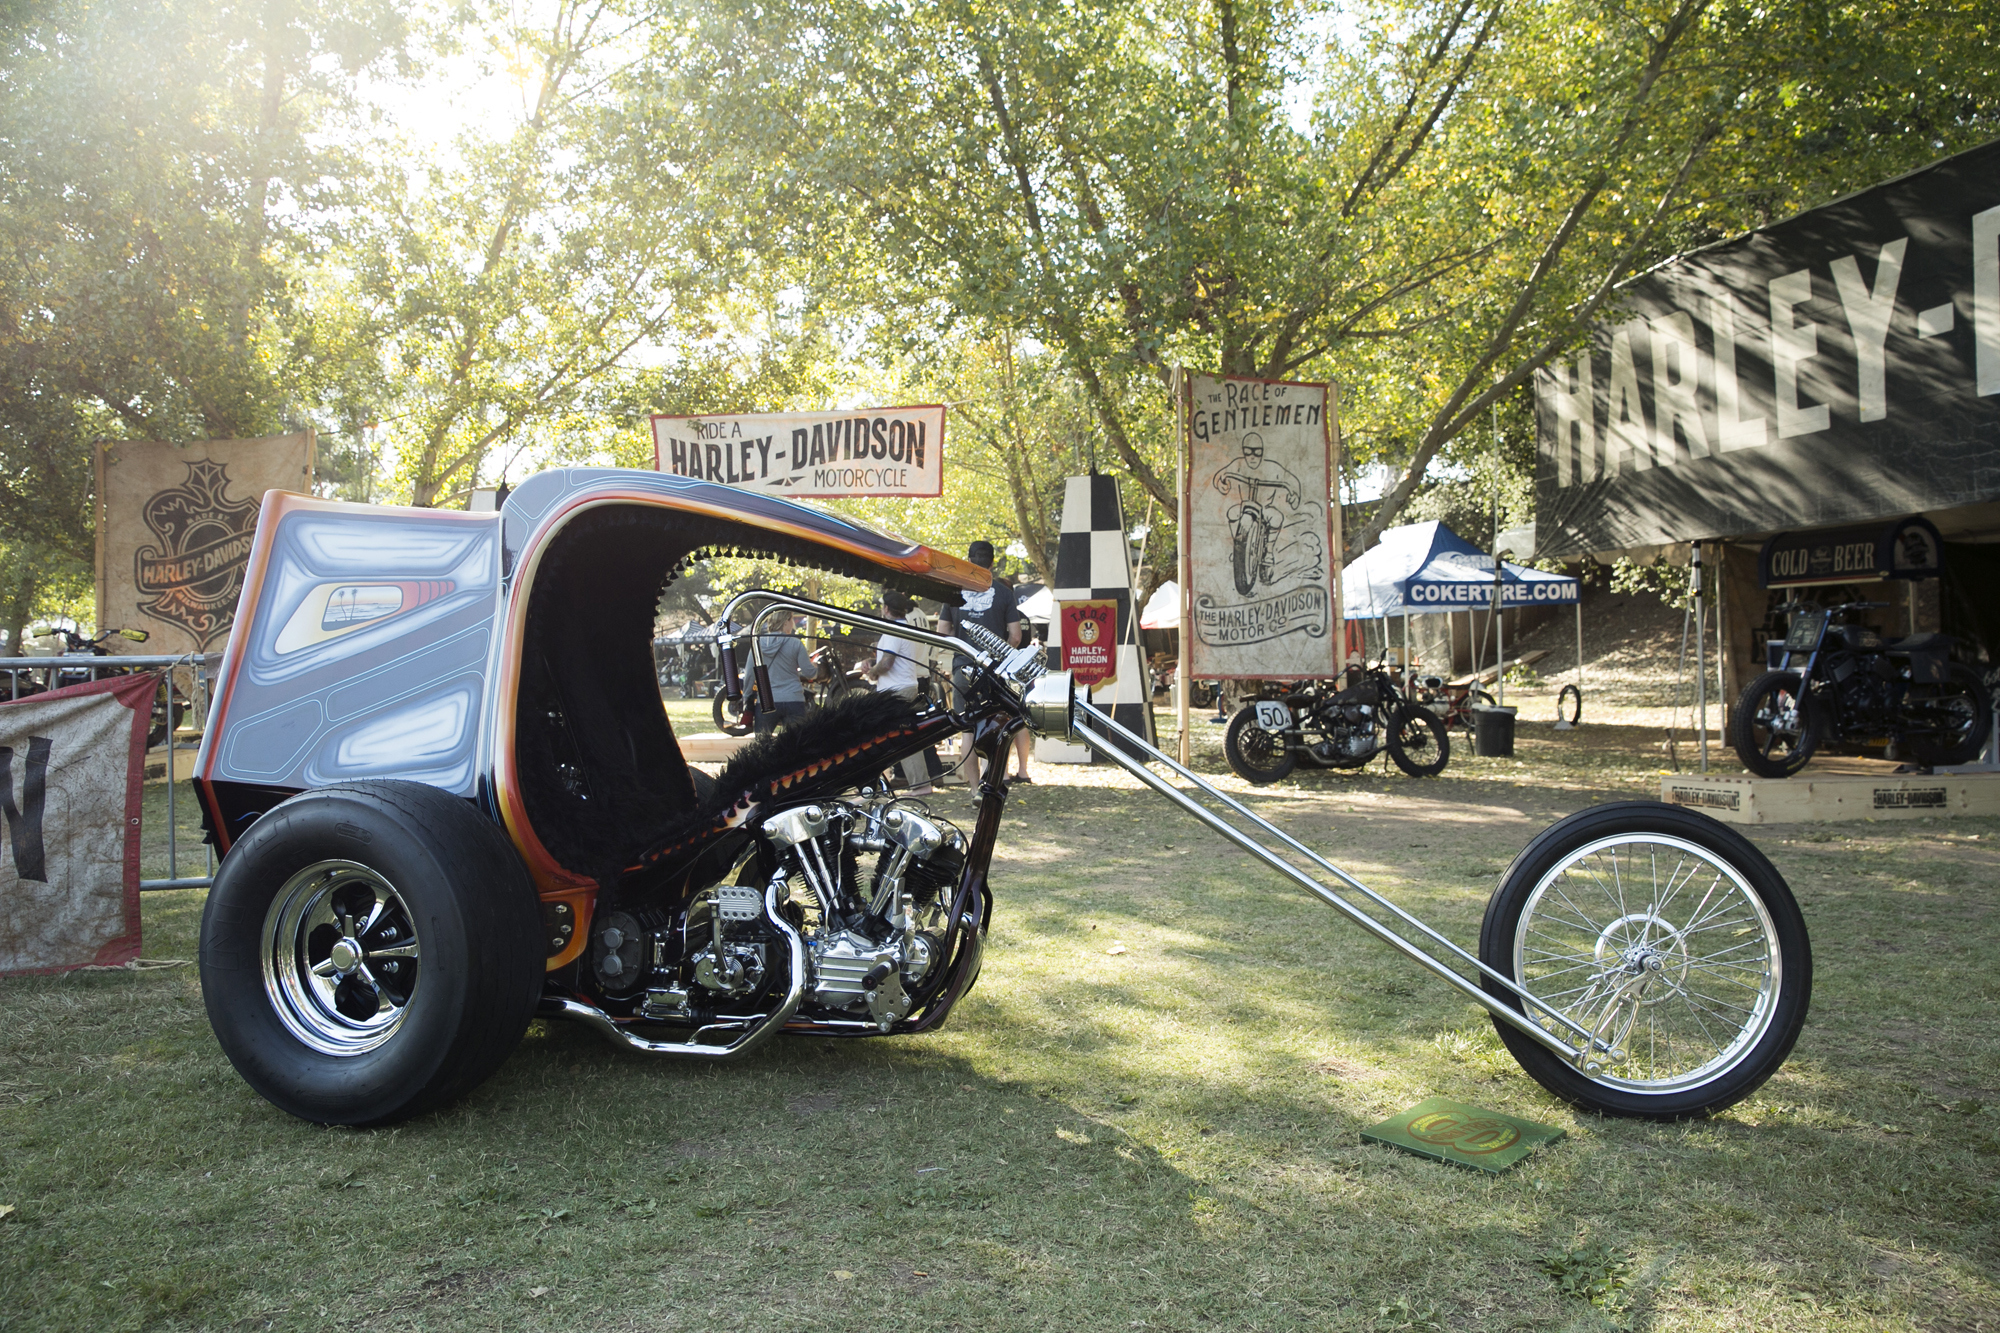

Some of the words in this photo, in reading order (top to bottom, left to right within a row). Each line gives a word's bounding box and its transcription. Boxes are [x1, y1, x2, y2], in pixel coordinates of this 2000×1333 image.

[1208, 393, 1221, 403] THE
[1225, 383, 1271, 410] RACE
[1274, 387, 1287, 398] OF
[697, 422, 727, 440] RIDE
[731, 421, 742, 438] A
[1193, 404, 1321, 443] GENTLEMEN
[669, 417, 926, 484] HARLEY-DAVIDSON
[814, 468, 907, 488] MOTORCYCLE
[186, 511, 214, 525] MADE
[217, 513, 230, 521] BY
[142, 533, 255, 584] HARLEY-DAVIDS
[1772, 549, 1808, 576] COLD
[1834, 542, 1875, 572] BEER
[1411, 583, 1577, 601] COKERTRE.COM
[1200, 610, 1216, 622] THE
[1218, 624, 1265, 641] MOTOR
[1069, 655, 1108, 664] DAVIDSON
[1071, 646, 1106, 655] HARLEY-
